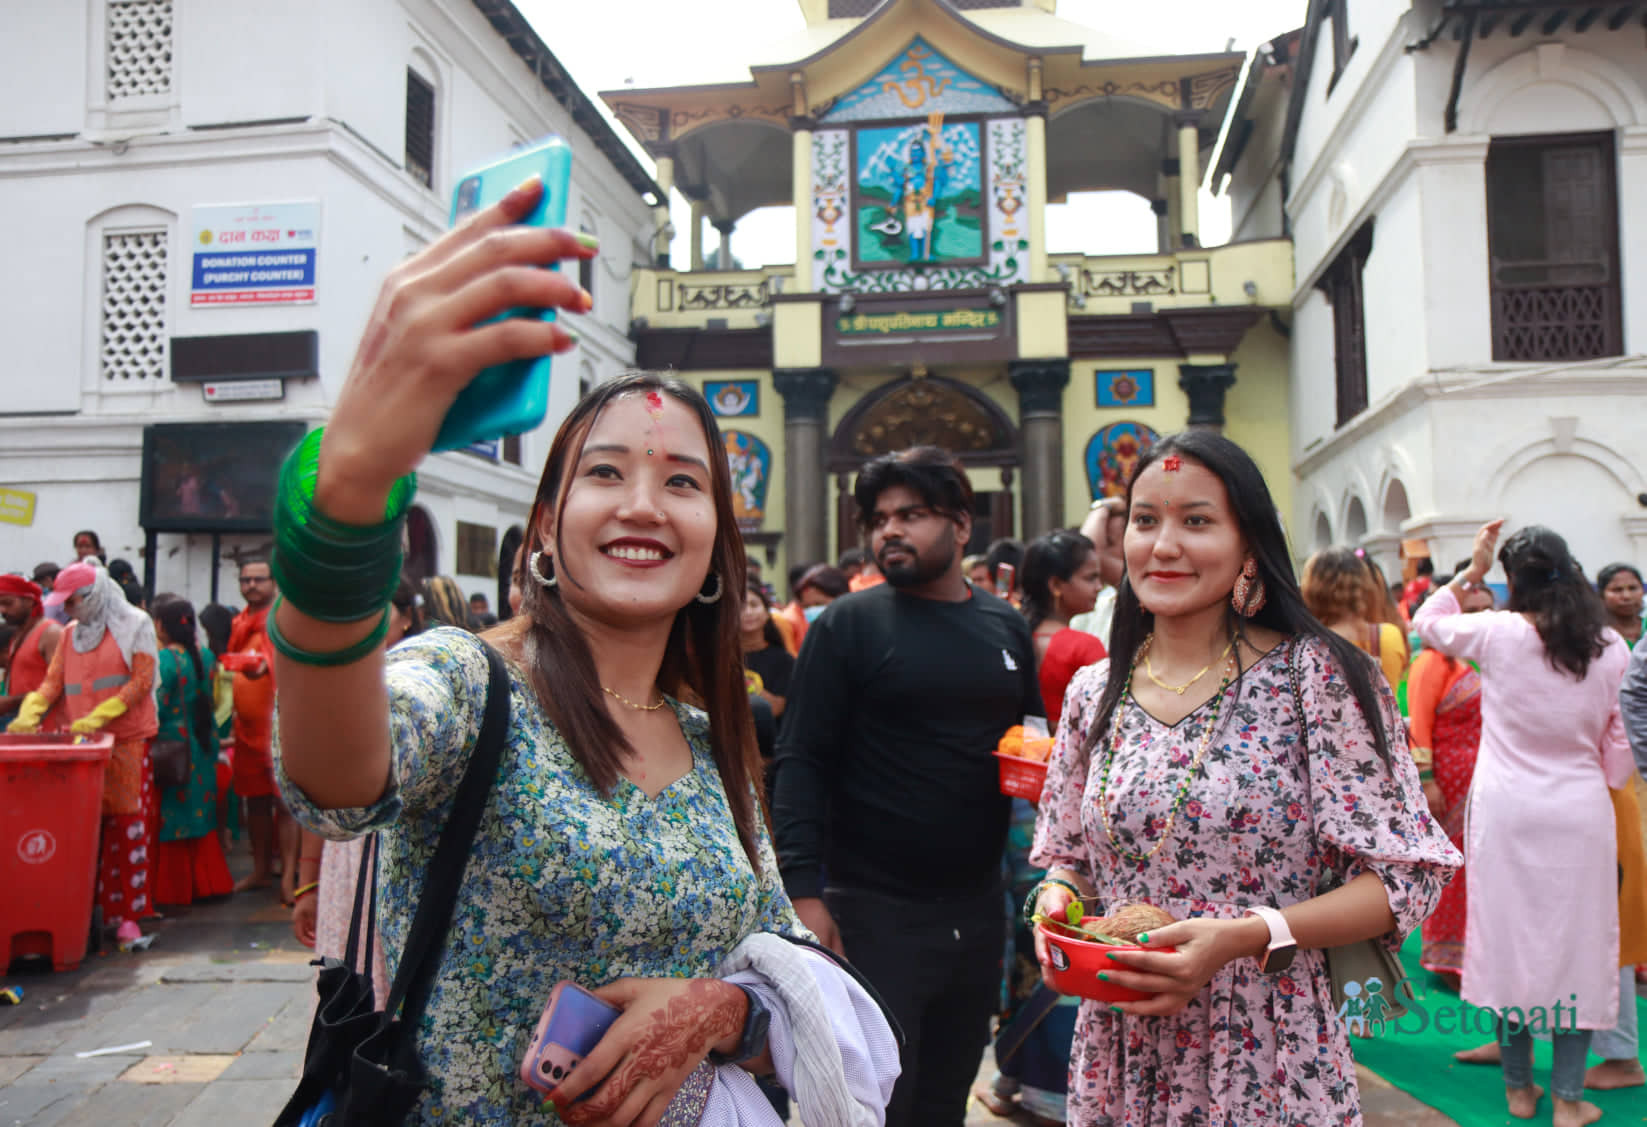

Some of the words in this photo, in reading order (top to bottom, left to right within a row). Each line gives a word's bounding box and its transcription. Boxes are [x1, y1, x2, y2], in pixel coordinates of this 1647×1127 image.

[201, 256, 256, 269] DONATION
[257, 254, 307, 266] COUNTER
[251, 269, 304, 281] COUNTER)
